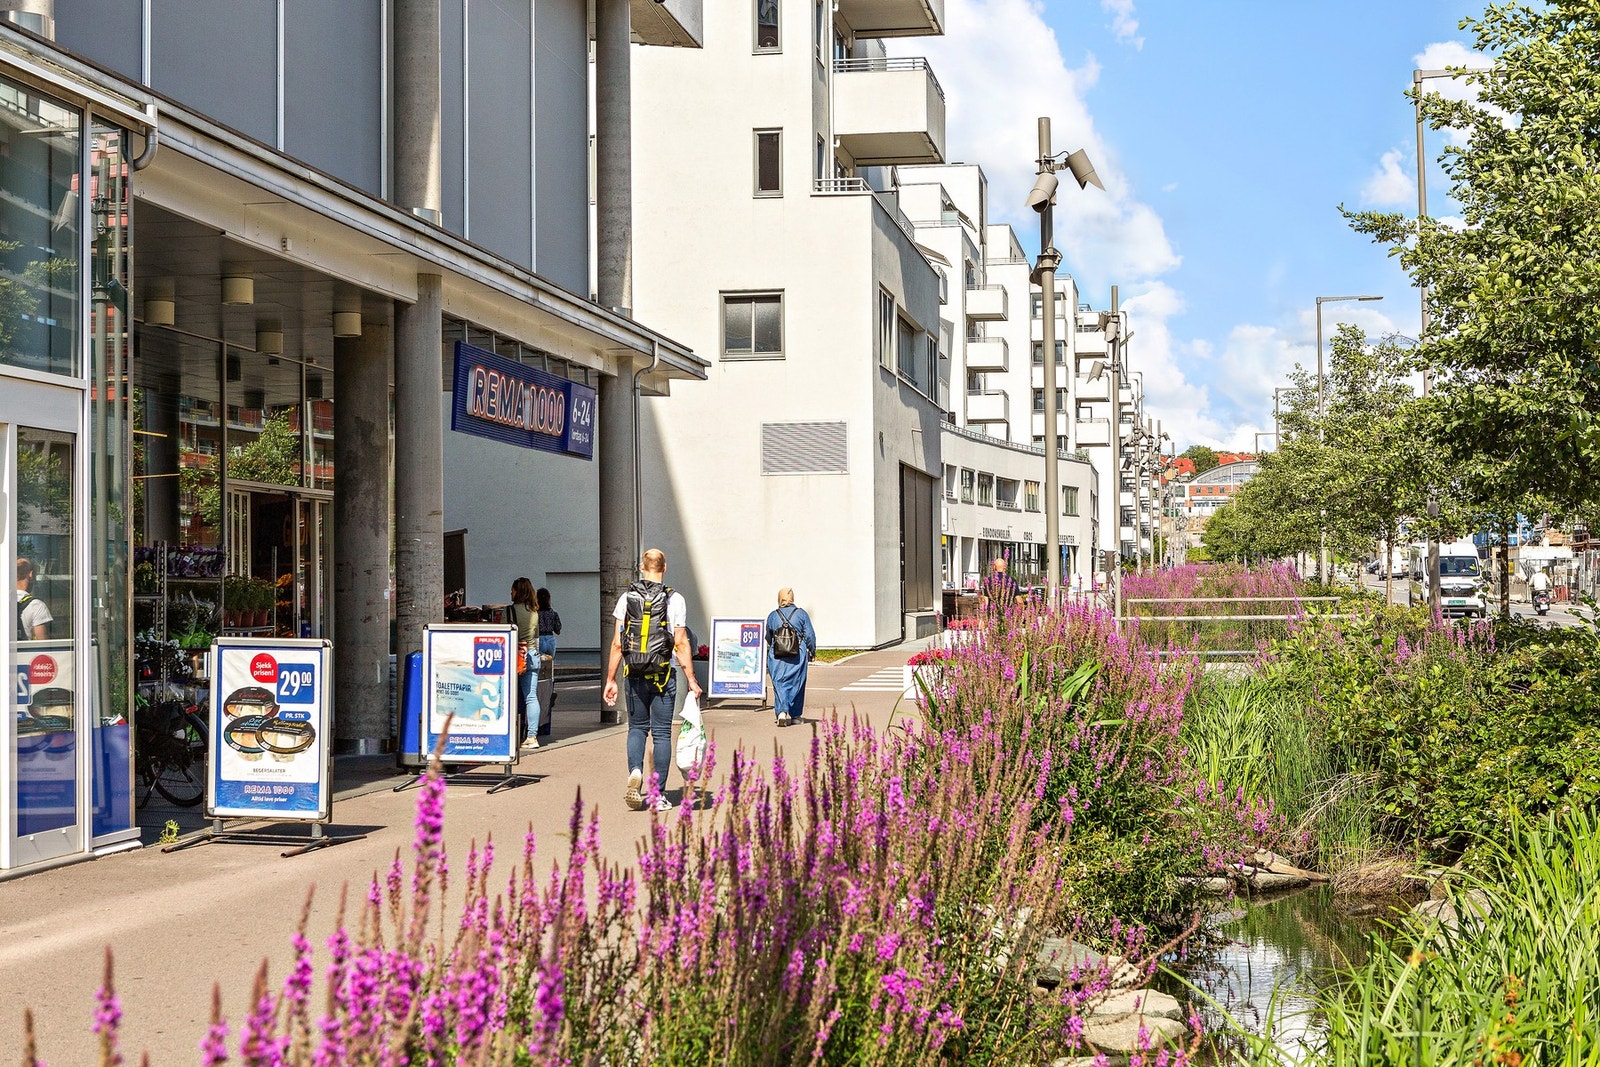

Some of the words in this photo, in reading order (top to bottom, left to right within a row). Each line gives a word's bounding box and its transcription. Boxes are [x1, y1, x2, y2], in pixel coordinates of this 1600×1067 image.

[473, 364, 526, 428] REMA
[528, 384, 566, 436] 1000
[572, 398, 591, 427] 6-24
[255, 661, 272, 669] Sjekk
[253, 669, 275, 677] prisen!
[449, 736, 472, 744] REMA
[244, 784, 272, 794] REMA
[273, 785, 295, 795] 1000
